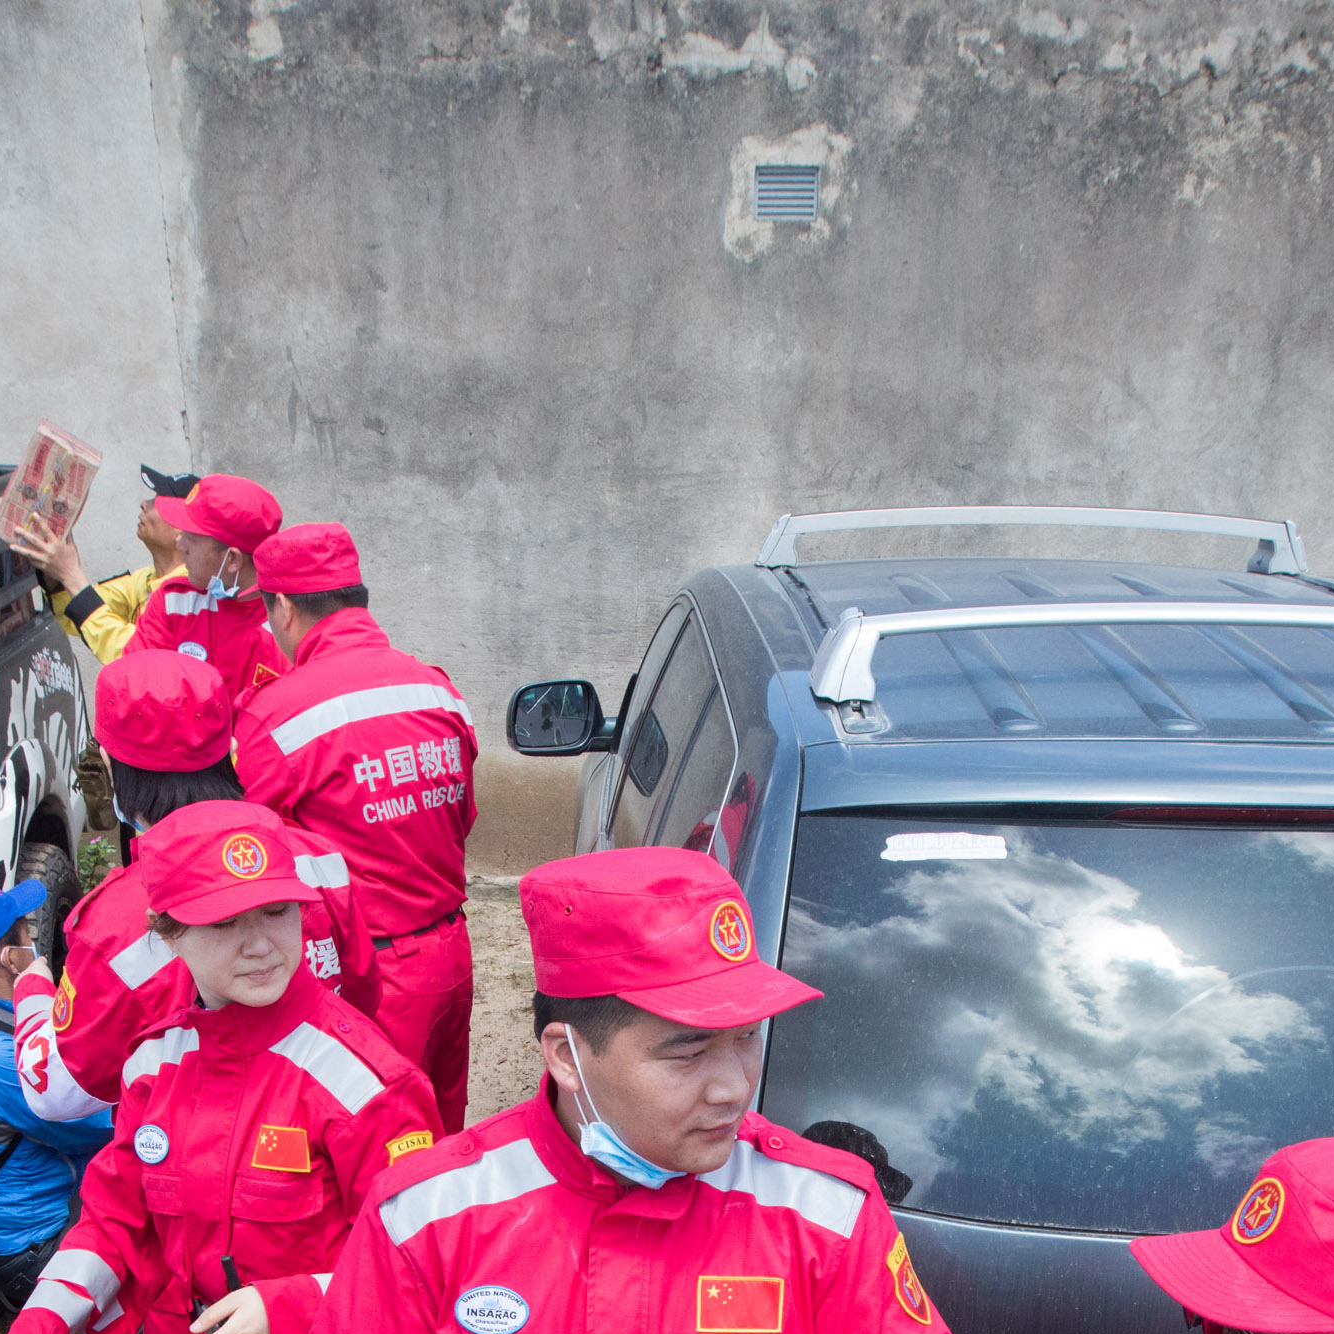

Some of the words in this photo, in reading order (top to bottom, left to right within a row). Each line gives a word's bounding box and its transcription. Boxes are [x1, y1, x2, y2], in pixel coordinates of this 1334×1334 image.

[353, 736, 463, 792] 中国救援
[362, 794, 418, 824] CHINA
[421, 783, 466, 810] RESCUE
[304, 936, 342, 980] 援
[139, 1141, 163, 1151] INSARAG
[397, 1136, 428, 1152] CISAR
[462, 1290, 491, 1304] UNITED
[493, 1290, 524, 1307] NATIONS
[466, 1307, 517, 1320] INSARAG
